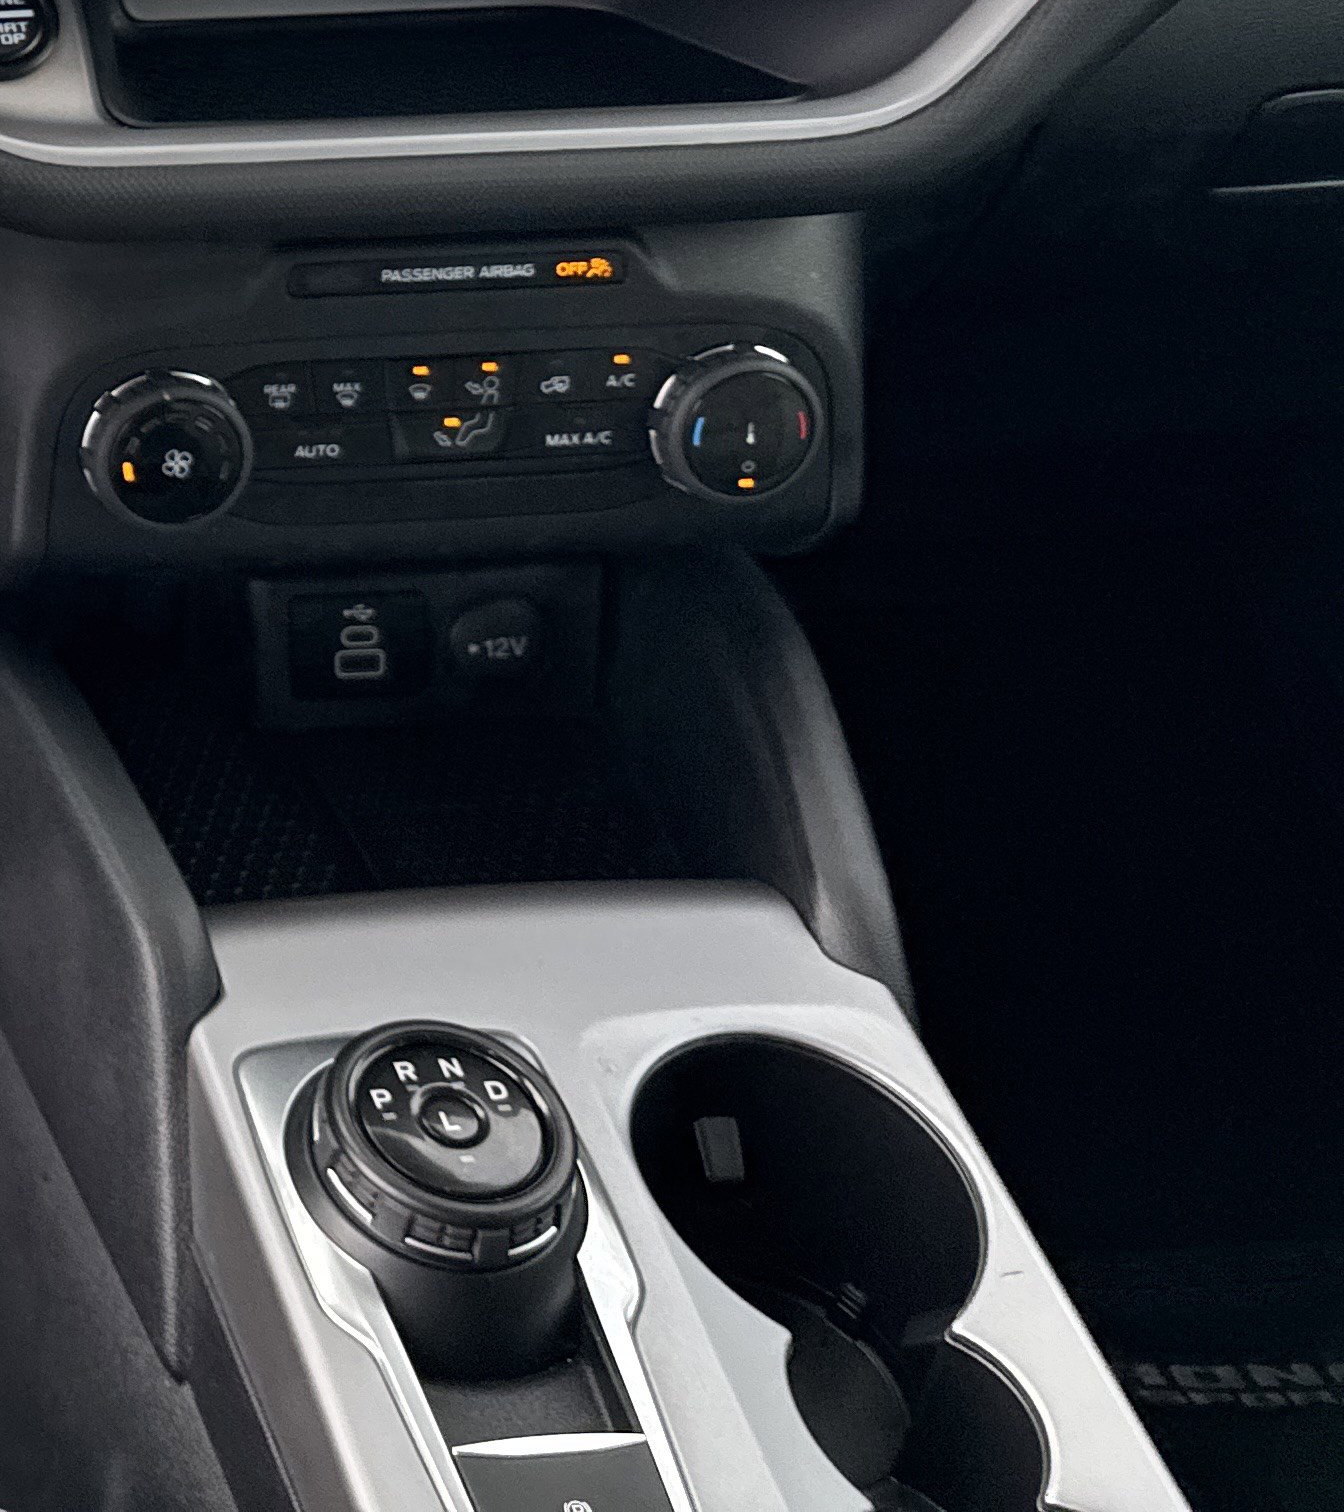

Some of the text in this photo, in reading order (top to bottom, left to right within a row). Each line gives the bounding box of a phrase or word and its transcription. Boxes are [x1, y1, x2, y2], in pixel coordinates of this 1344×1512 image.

[381, 261, 587, 282] PASSENGER AIRBAG OFF
[606, 374, 636, 388] A/C
[545, 430, 612, 447] MAX A/C
[294, 444, 339, 458] AUTO
[393, 1057, 464, 1082] R N
[370, 1088, 393, 1110] P
[484, 1080, 509, 1101] D
[438, 1111, 461, 1131] L
